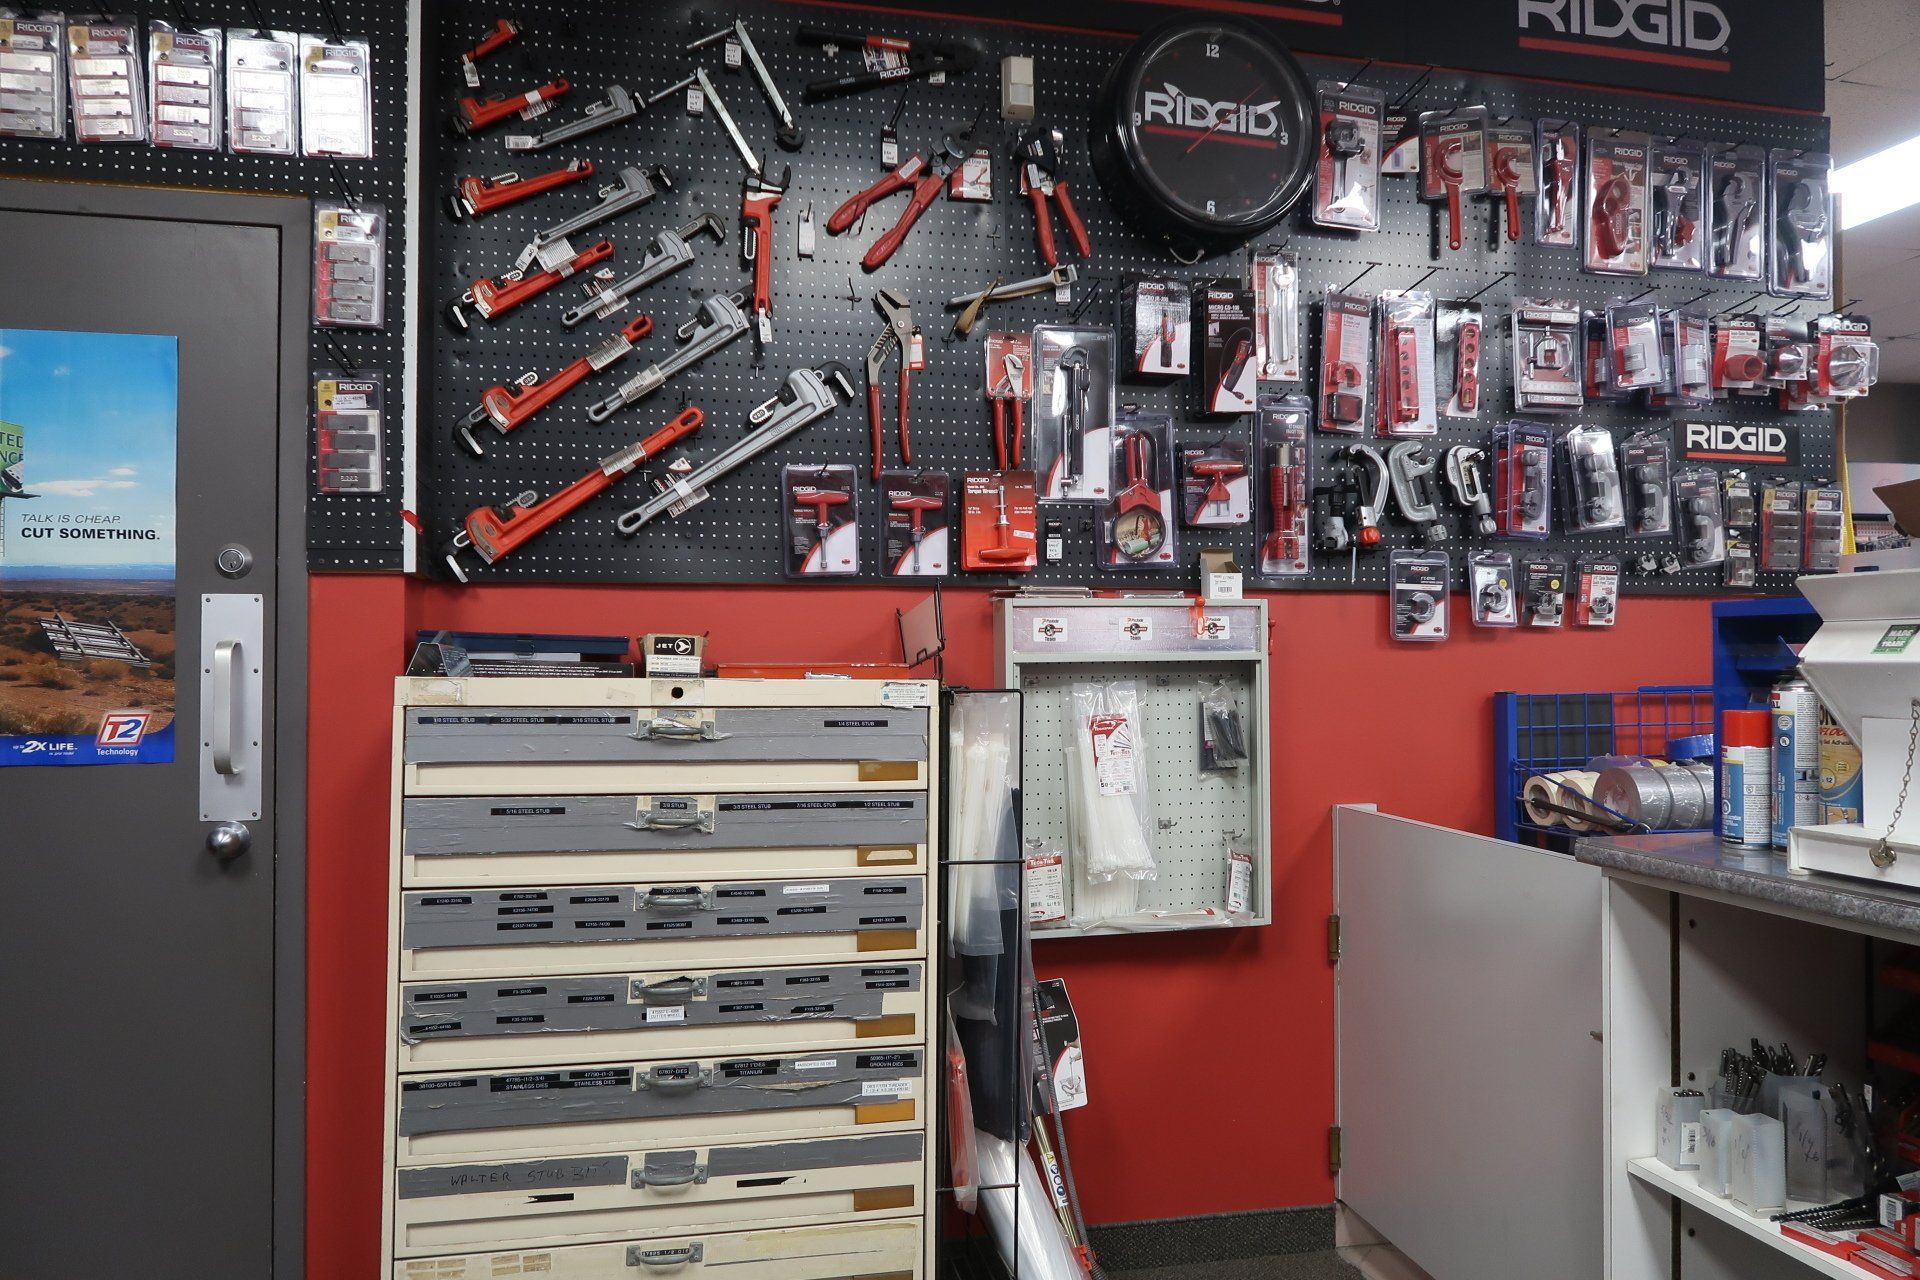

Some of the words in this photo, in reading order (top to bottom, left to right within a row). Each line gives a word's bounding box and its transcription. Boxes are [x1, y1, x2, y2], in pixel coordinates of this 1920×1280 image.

[16, 22, 54, 34] RIDGID
[91, 28, 128, 39] RIDGID
[175, 37, 211, 47] RIDGID
[1206, 43, 1220, 58] 12
[880, 66, 912, 79] RIDGID
[1338, 100, 1377, 115] RIDGID
[1133, 112, 1141, 126] 9
[1144, 91, 1278, 139] RIDGID
[1439, 123, 1470, 133] RIDGID
[1280, 131, 1289, 146] 3
[1498, 134, 1523, 142] RIDGID
[1614, 147, 1643, 158] RIDGID
[1663, 156, 1688, 165] RIDGID
[1713, 161, 1736, 169] RIDGID
[1206, 200, 1216, 216] 6
[1138, 282, 1166, 292] RIDGID
[1207, 291, 1235, 300] RIDGID
[1344, 301, 1369, 313] RIDGID
[1627, 316, 1650, 325] RIDGID
[1833, 320, 1869, 332] RIDGID
[339, 383, 374, 392] RIDGID
[1543, 394, 1566, 403] RIDGID
[1525, 435, 1545, 443] RIDGID
[1685, 423, 1788, 453] RIDGID
[792, 485, 818, 493] RIDGID
[887, 490, 912, 498] RIDGID
[1776, 490, 1799, 499] RIDGID
[1818, 490, 1841, 499] RIDGID
[21, 513, 53, 524] TALK
[57, 513, 71, 524] IS
[21, 528, 56, 540] CUT
[59, 529, 161, 541] SOMETHING.
[1530, 564, 1549, 572] RIDGID
[1593, 564, 1617, 572] RIDGID
[107, 719, 142, 742] T2
[22, 740, 47, 754] 2X
[97, 748, 139, 758] Technology
[450, 1172, 512, 1187] WALTER
